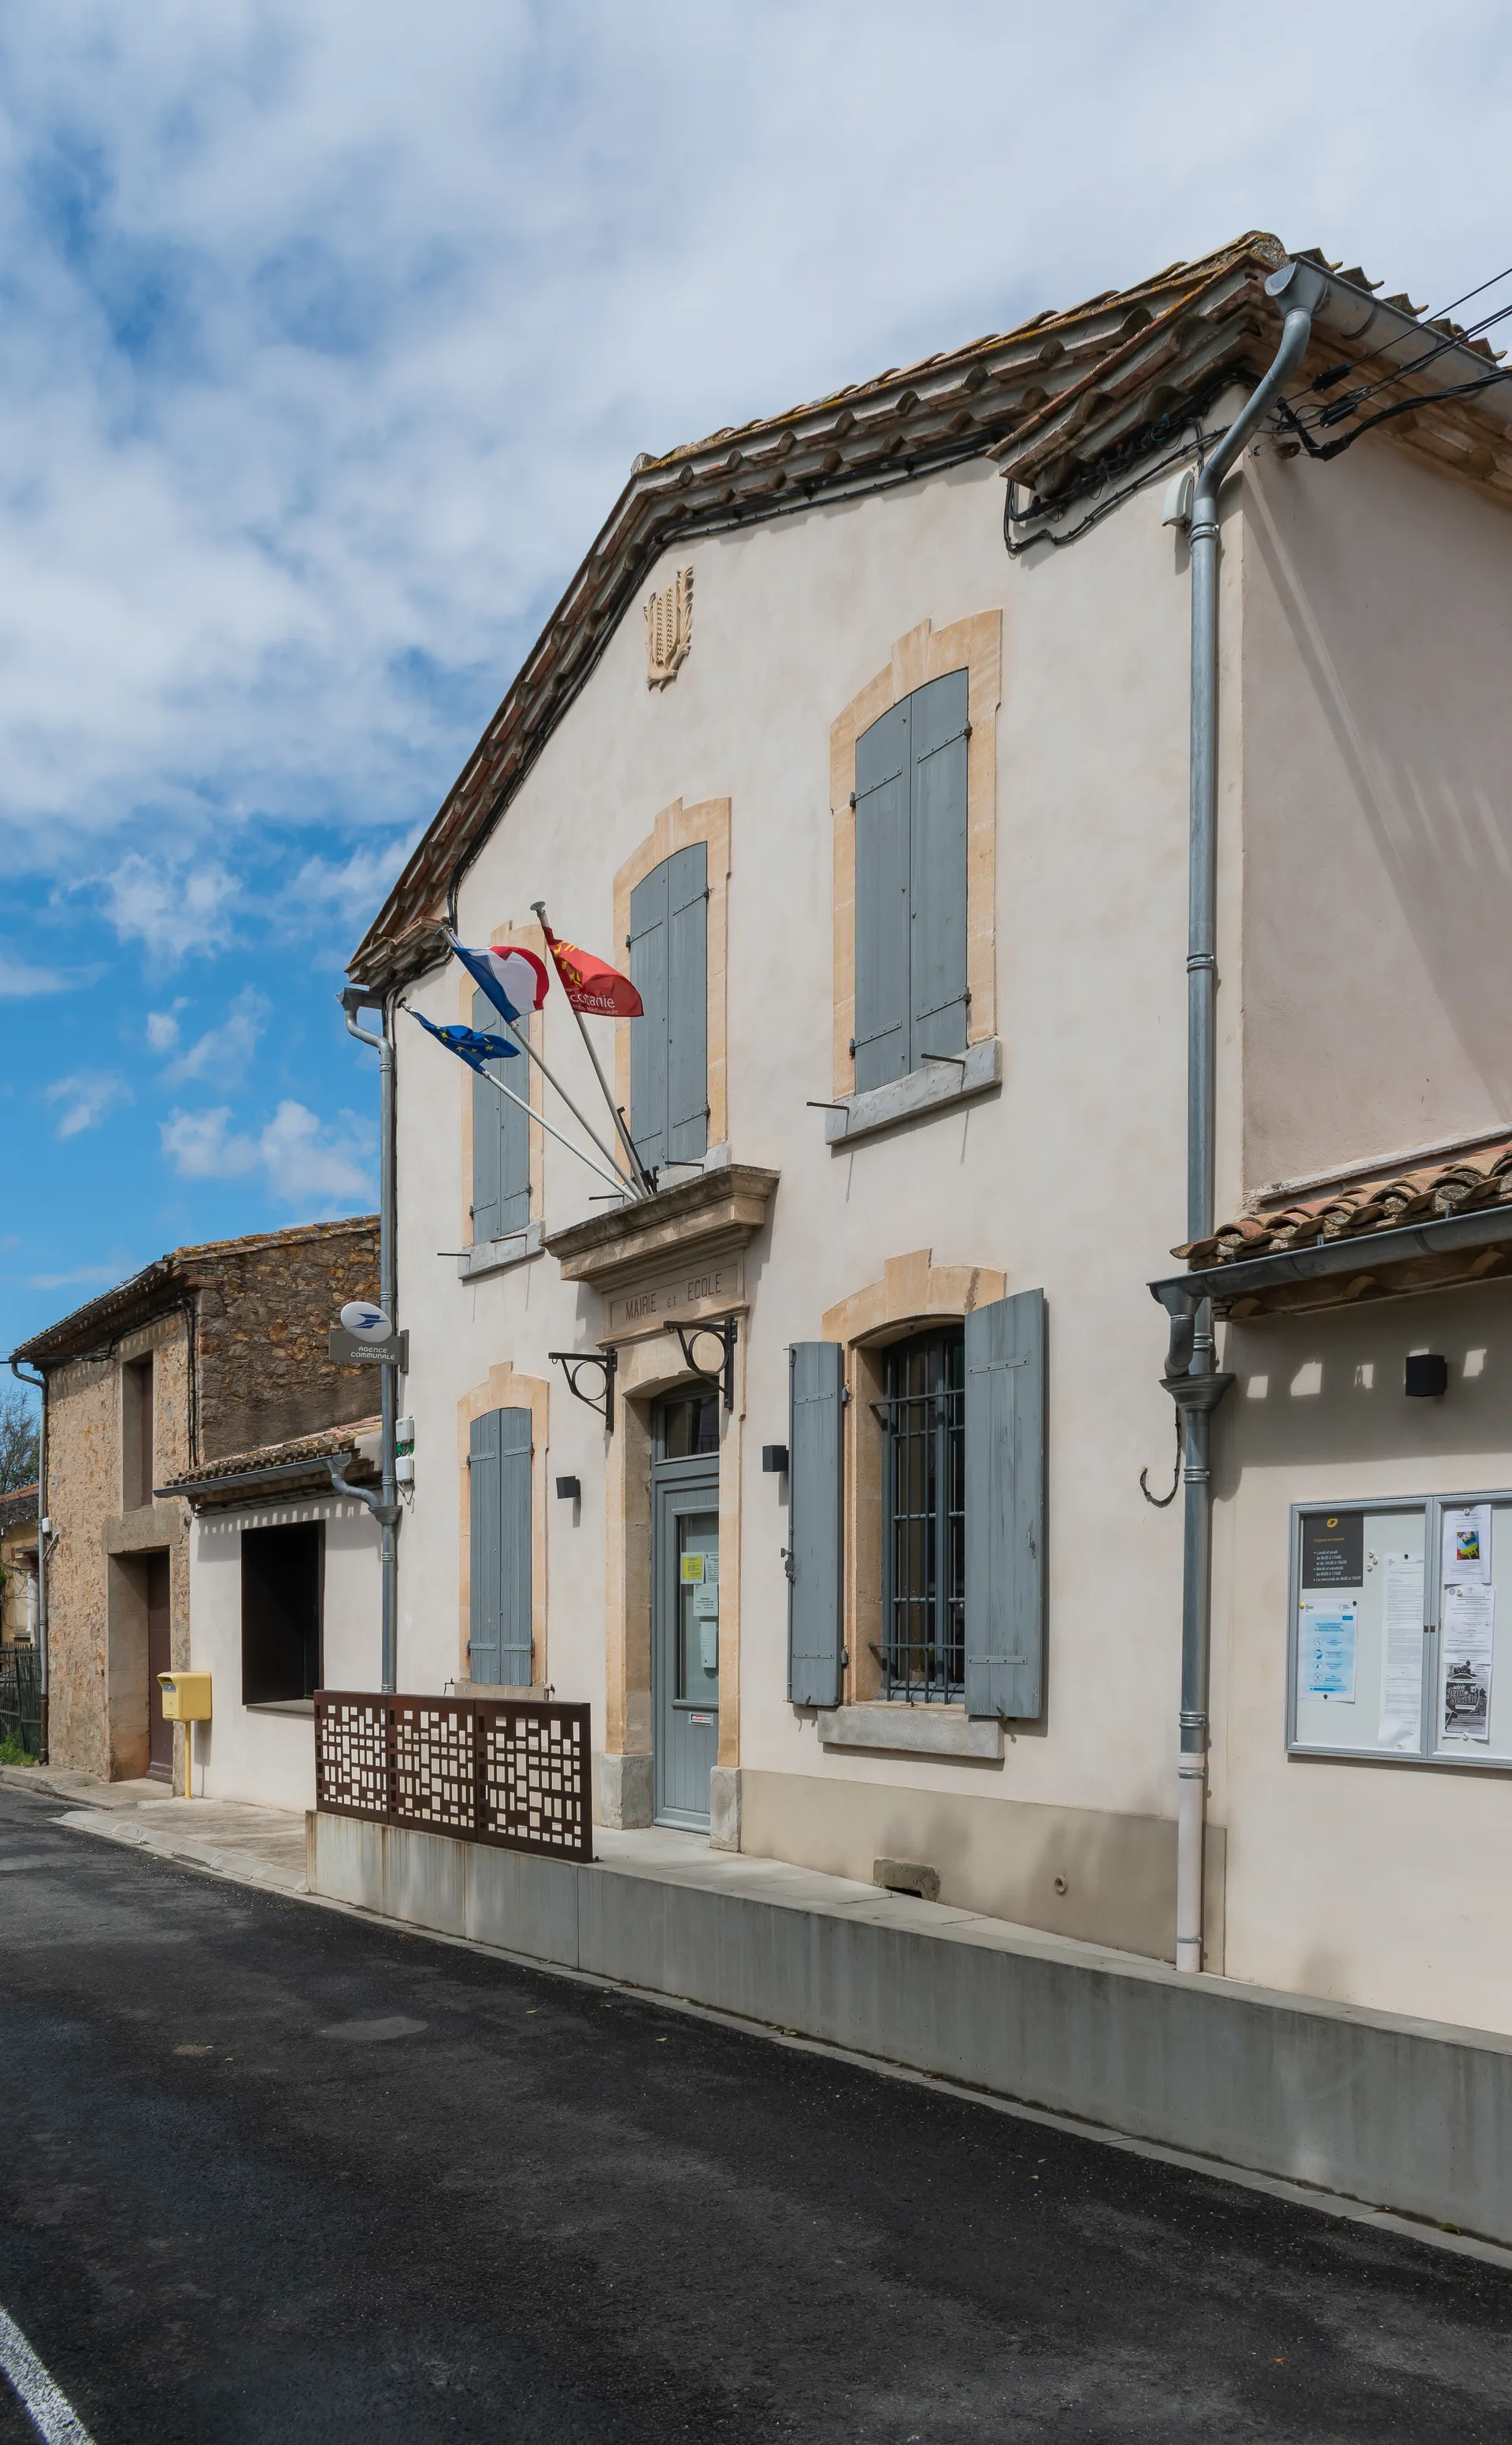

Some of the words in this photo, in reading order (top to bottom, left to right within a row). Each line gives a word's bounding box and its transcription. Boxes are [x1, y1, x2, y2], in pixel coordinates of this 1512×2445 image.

[570, 993, 615, 1007] ccitanie
[625, 1293, 657, 1320] MAIRIE
[667, 1296, 676, 1308] ET
[687, 1273, 722, 1302] ECOLE
[350, 1352, 395, 1360] COMMUNALE
[1451, 1693, 1477, 1705] Société
